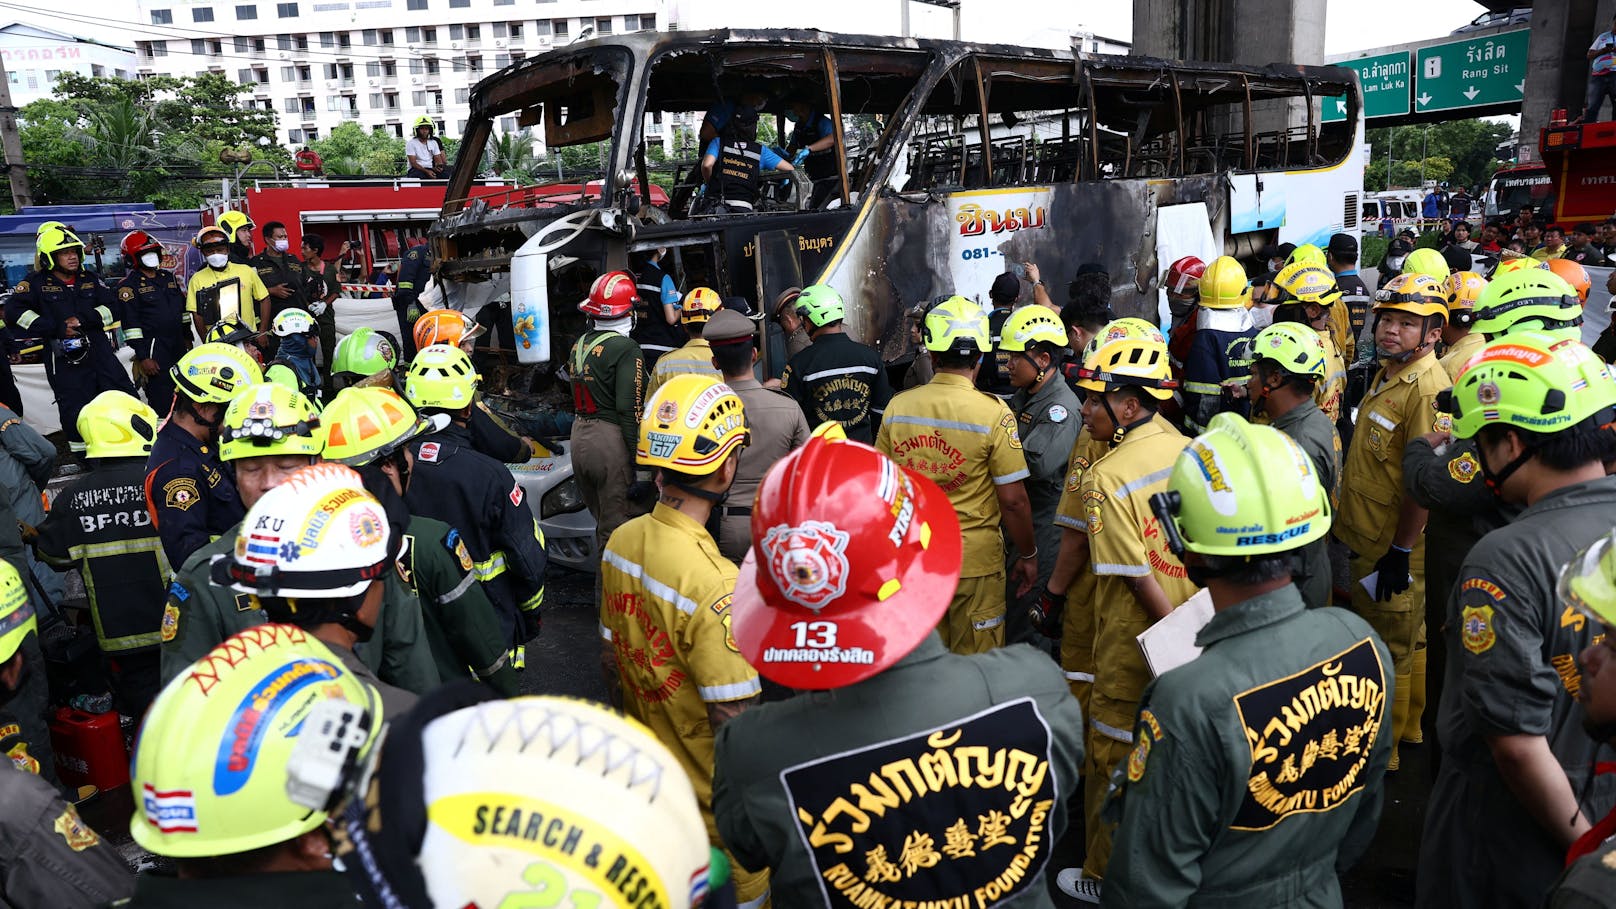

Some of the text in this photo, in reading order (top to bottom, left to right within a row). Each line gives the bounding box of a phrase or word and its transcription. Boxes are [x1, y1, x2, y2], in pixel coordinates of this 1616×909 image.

[1466, 41, 1506, 63] รังสิต
[1363, 61, 1406, 81] อ.ลำลูกกา
[1431, 67, 1435, 76] 1
[1462, 64, 1509, 79] Rang Sit
[1365, 80, 1405, 93] Lam Luk Ka
[956, 203, 1045, 236] ชินบ
[962, 247, 1005, 260] 081-
[650, 441, 675, 458] 67
[893, 430, 967, 470] ร่วมกตัญญู
[79, 510, 152, 533] BFRD
[888, 496, 914, 548] FIRE
[1236, 522, 1311, 547] RESCUE
[790, 621, 838, 648] 13
[763, 646, 874, 665] ปากคลองรังสิต
[1248, 662, 1384, 764] ร่วมกตัญญู
[0, 726, 19, 738] CUE
[798, 729, 1048, 853] ร่วมกตัญญู
[473, 804, 665, 909] SEARCH & RESC
[974, 800, 1053, 909] FOUNDATION
